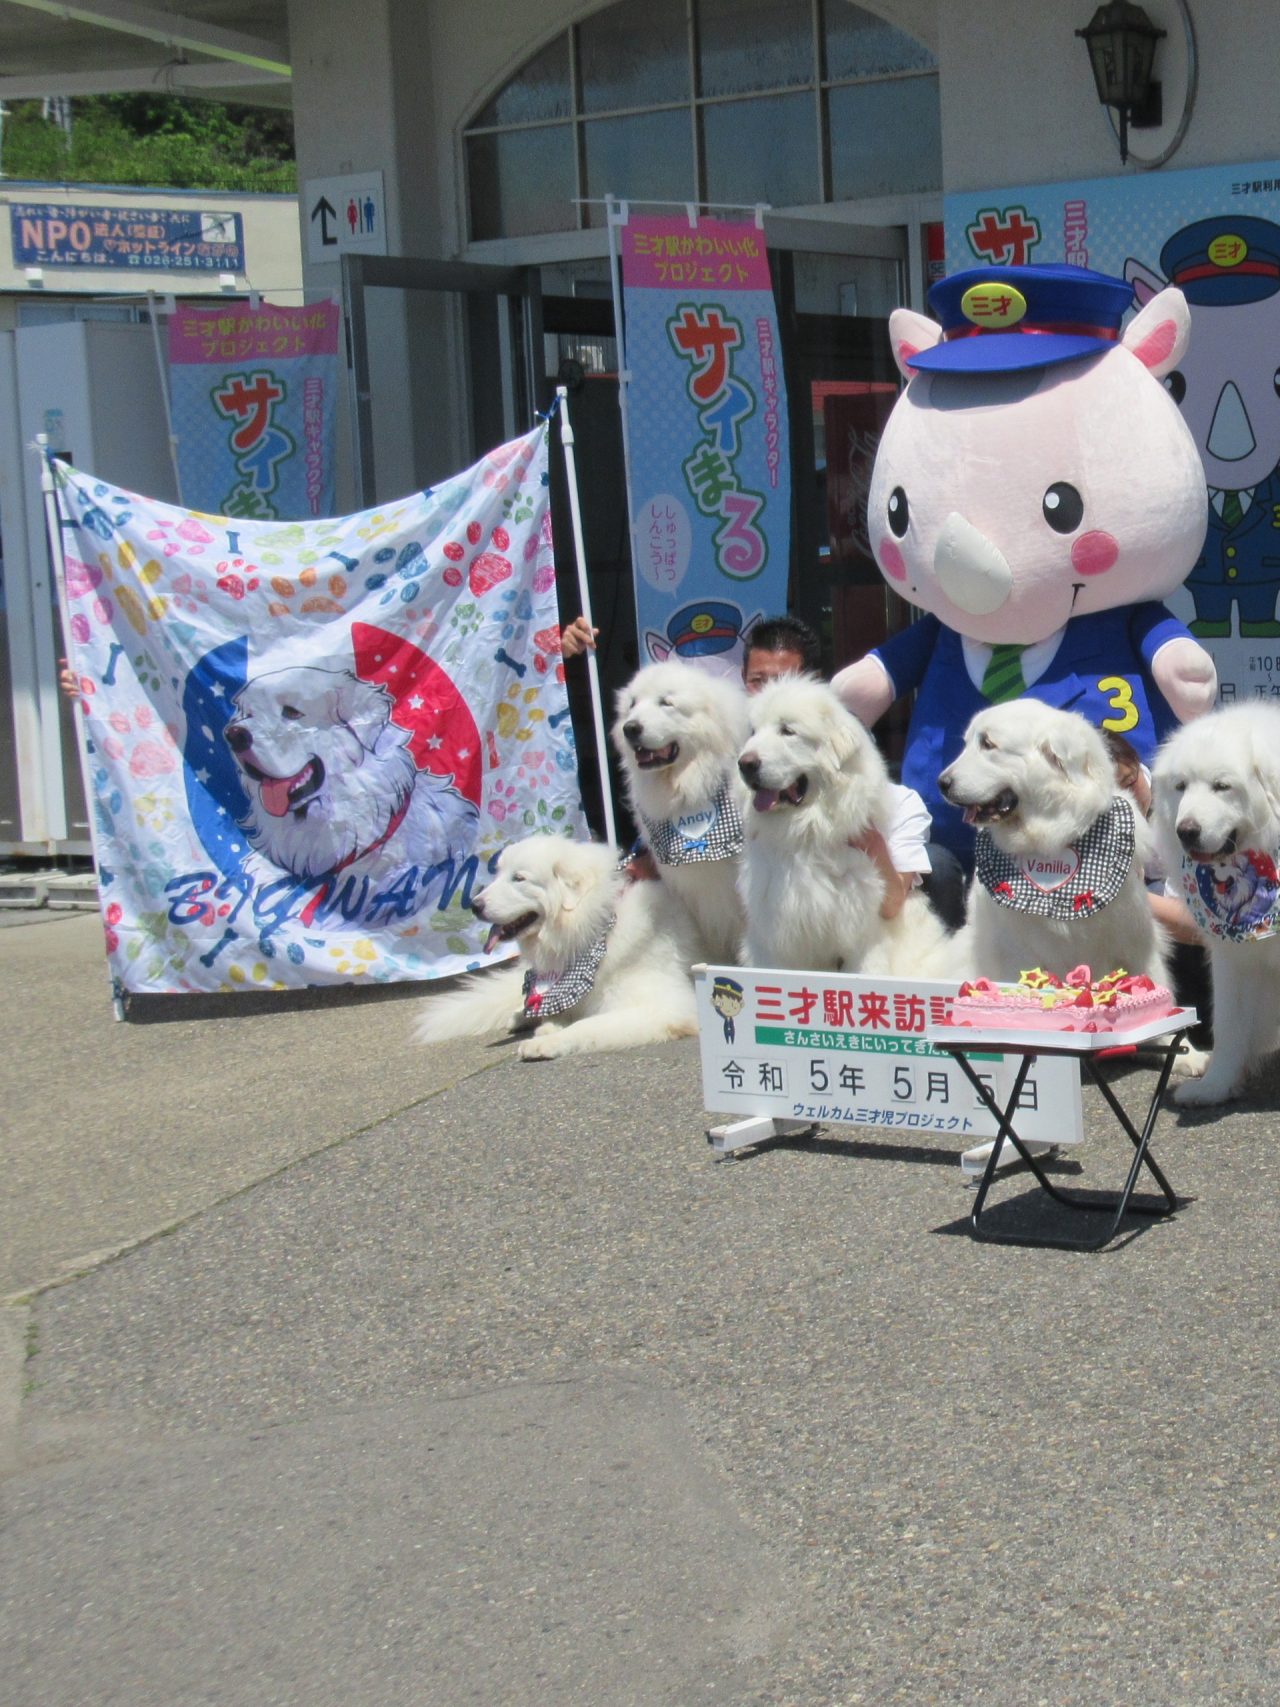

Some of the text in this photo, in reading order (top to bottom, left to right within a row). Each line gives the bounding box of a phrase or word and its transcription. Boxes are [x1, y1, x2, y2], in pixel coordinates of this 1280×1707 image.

[21, 219, 92, 252] NPO
[632, 233, 760, 258] 三才駅かわいい化
[1214, 242, 1243, 259] 三才
[655, 261, 749, 283] プロジェクト
[970, 296, 1013, 316] 三才
[182, 312, 327, 338] 三才駅かわいい化
[202, 335, 307, 358] プロジェクト
[756, 318, 779, 489] 三才駅キャラクター
[304, 377, 324, 516] 三才駅キャラクター
[667, 302, 769, 581] サイまる
[1097, 676, 1140, 733] 3
[677, 810, 713, 827] Andy
[1026, 858, 1072, 875] Vanilla
[164, 850, 500, 939] BIGWAN
[793, 1102, 974, 1131] ウェルカム三才児プロジェクト
